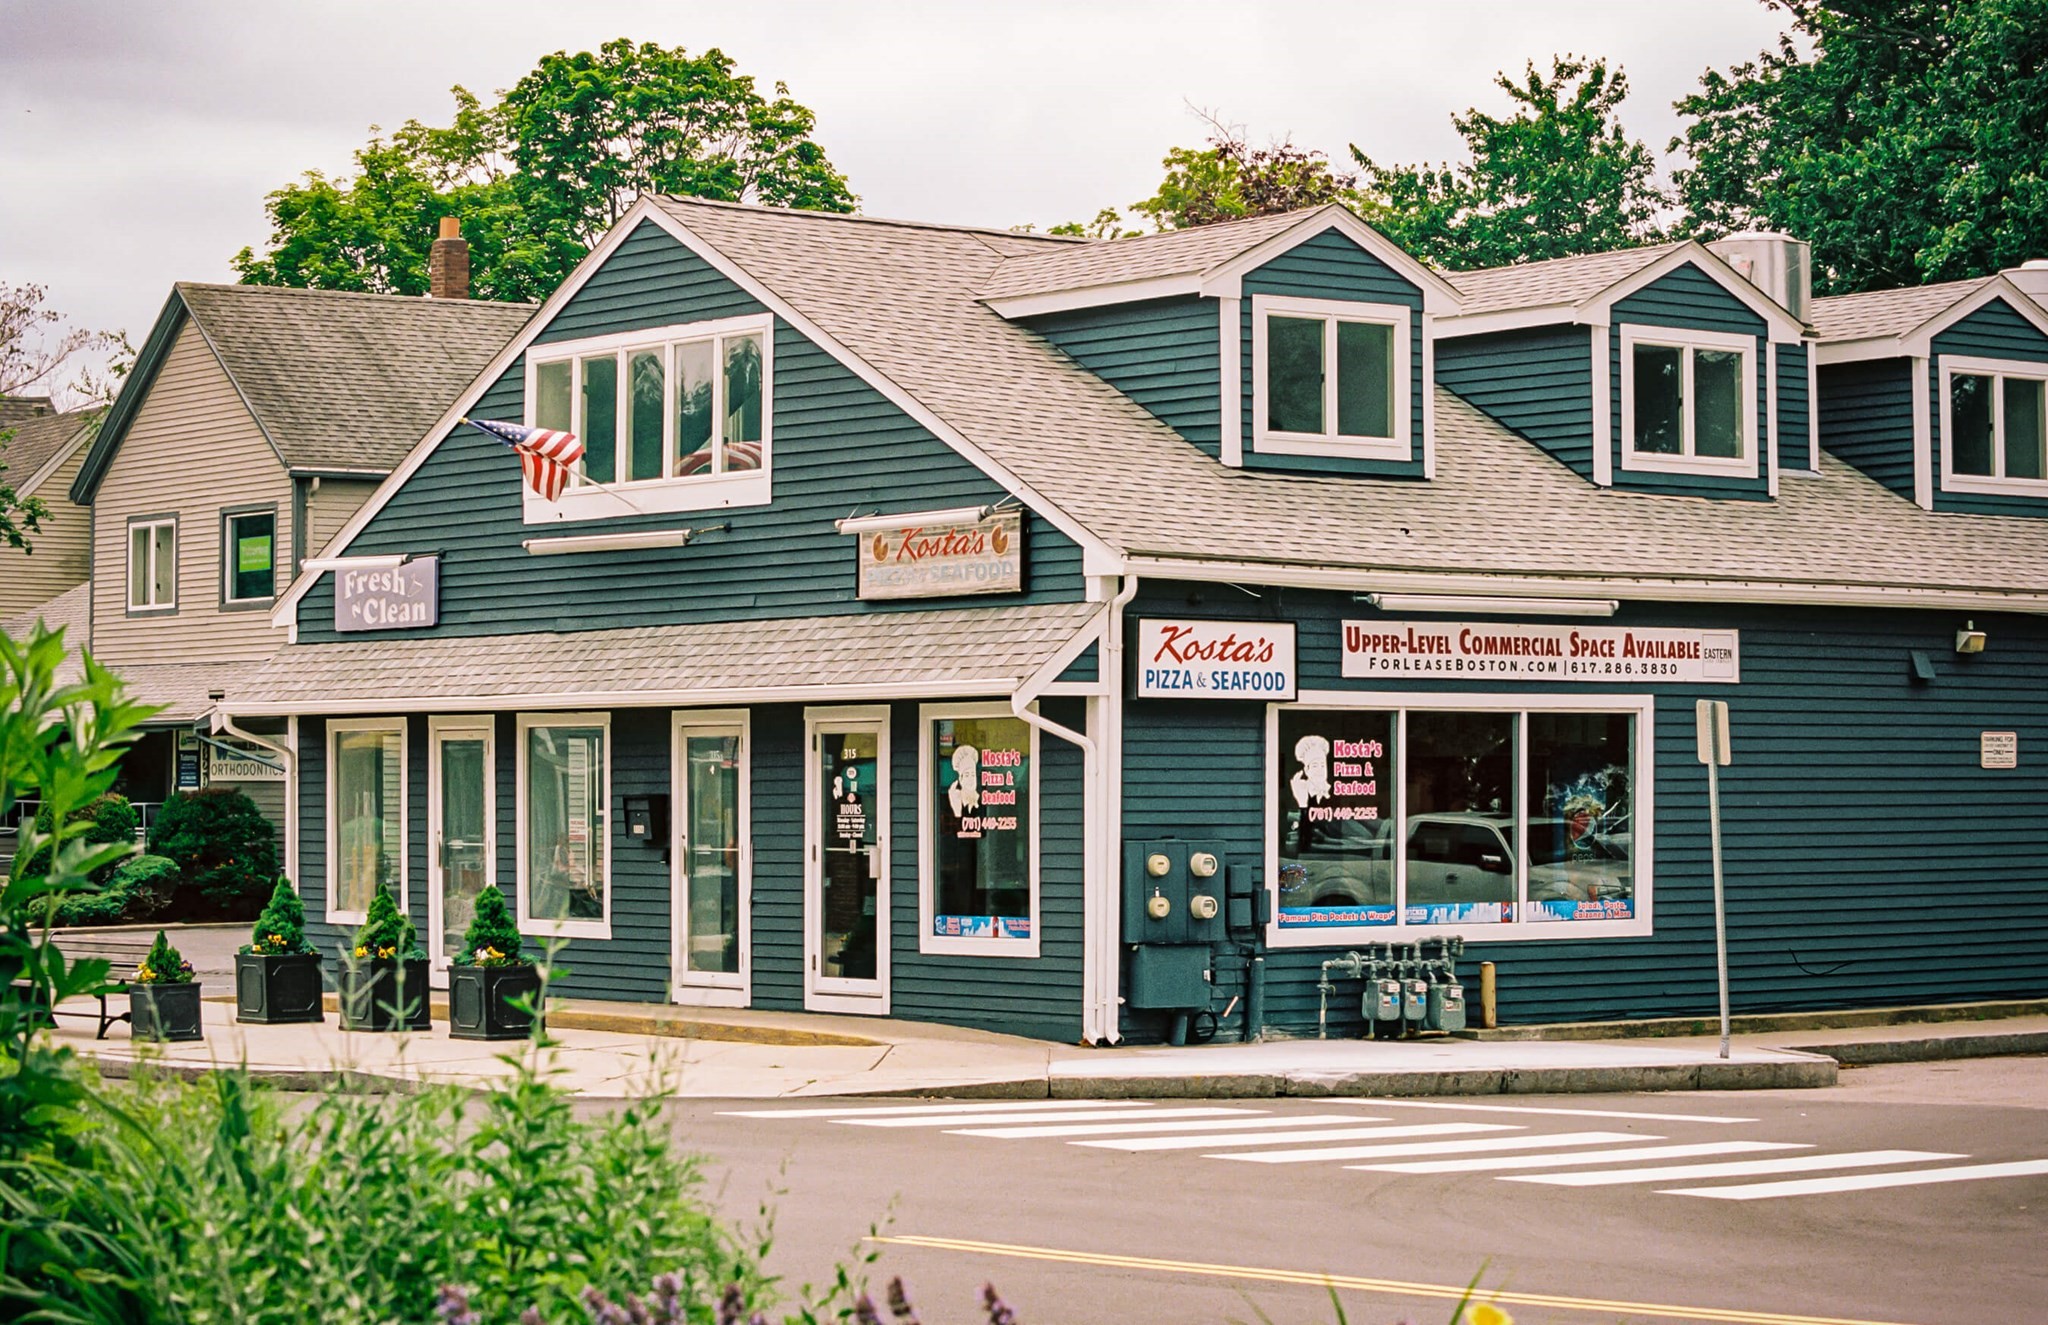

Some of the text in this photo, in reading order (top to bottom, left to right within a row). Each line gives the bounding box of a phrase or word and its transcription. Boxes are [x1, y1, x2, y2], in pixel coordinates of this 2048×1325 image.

[896, 527, 985, 562] Kosta's
[930, 560, 1014, 583] SEAFOOD
[344, 567, 406, 600] Fresh
[363, 597, 426, 625] Clean
[1154, 625, 1275, 664] Kosta's
[1346, 626, 1700, 659] UPPER-LEVEL COMMERCIAL SPACE AVAILABLE
[1703, 648, 1732, 660] EASTERN
[1369, 657, 1678, 675] FORLEASEBOSTON.COM 617.286.3830
[1146, 669, 1286, 691] PIZZA & SEAFOOD
[843, 748, 857, 759] 315
[981, 748, 1021, 767] Kosta's
[1333, 739, 1383, 758] Kosta's
[1333, 761, 1375, 777] Pizza &
[981, 771, 1015, 786] Pizza &
[1333, 780, 1377, 796] Seafood
[981, 790, 1016, 805] Seafood
[841, 803, 862, 815] HOURS
[1311, 911, 1328, 922] Pita
[1329, 911, 1359, 922] Pockets
